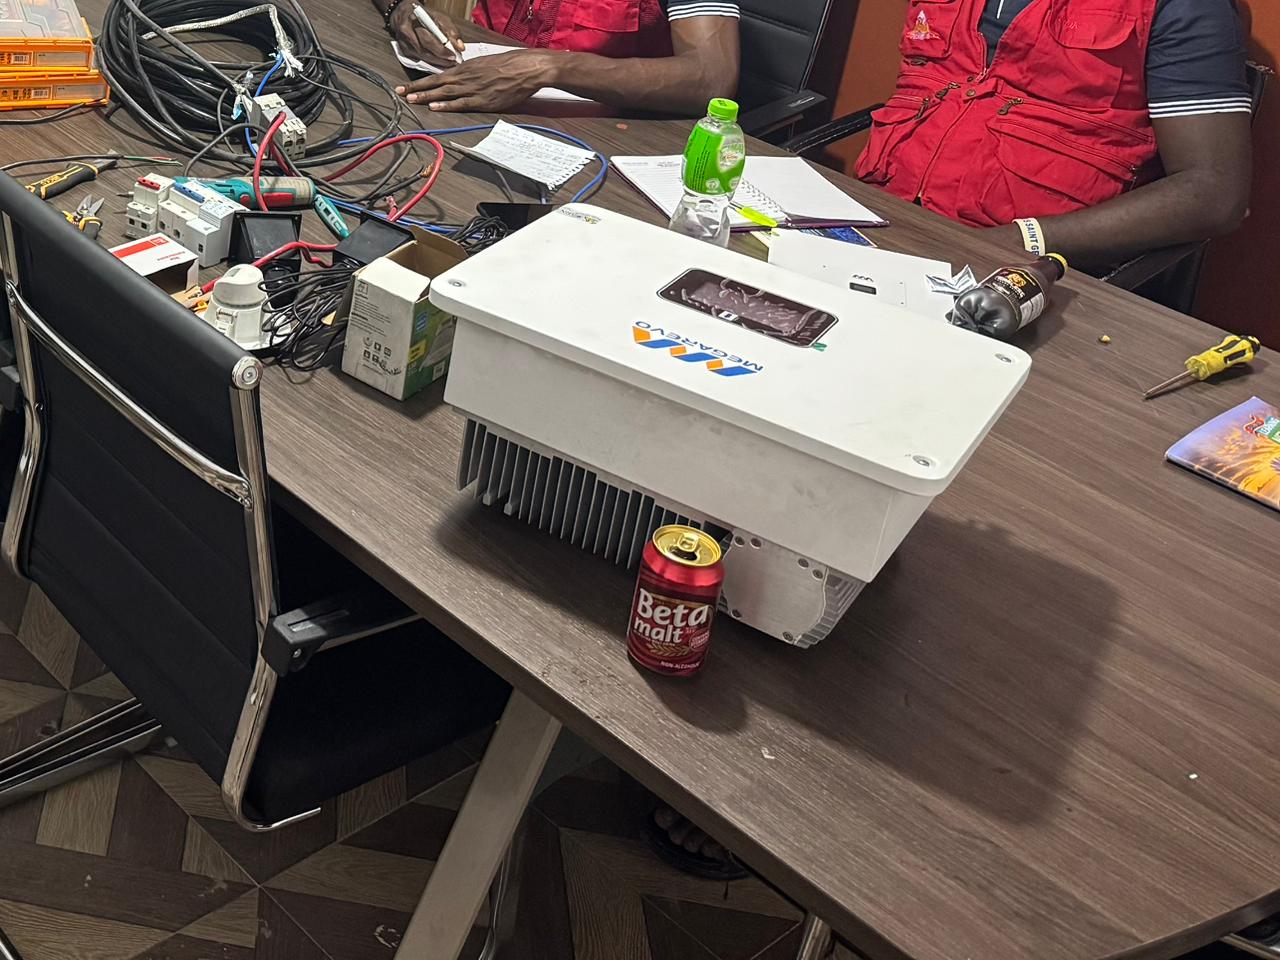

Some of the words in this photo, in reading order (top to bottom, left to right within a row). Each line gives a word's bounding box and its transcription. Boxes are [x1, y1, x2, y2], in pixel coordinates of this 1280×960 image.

[1025, 222, 1039, 243] SAINT
[635, 321, 764, 371] MEGAREVO
[637, 588, 709, 628] Beta
[634, 617, 684, 643] malt
